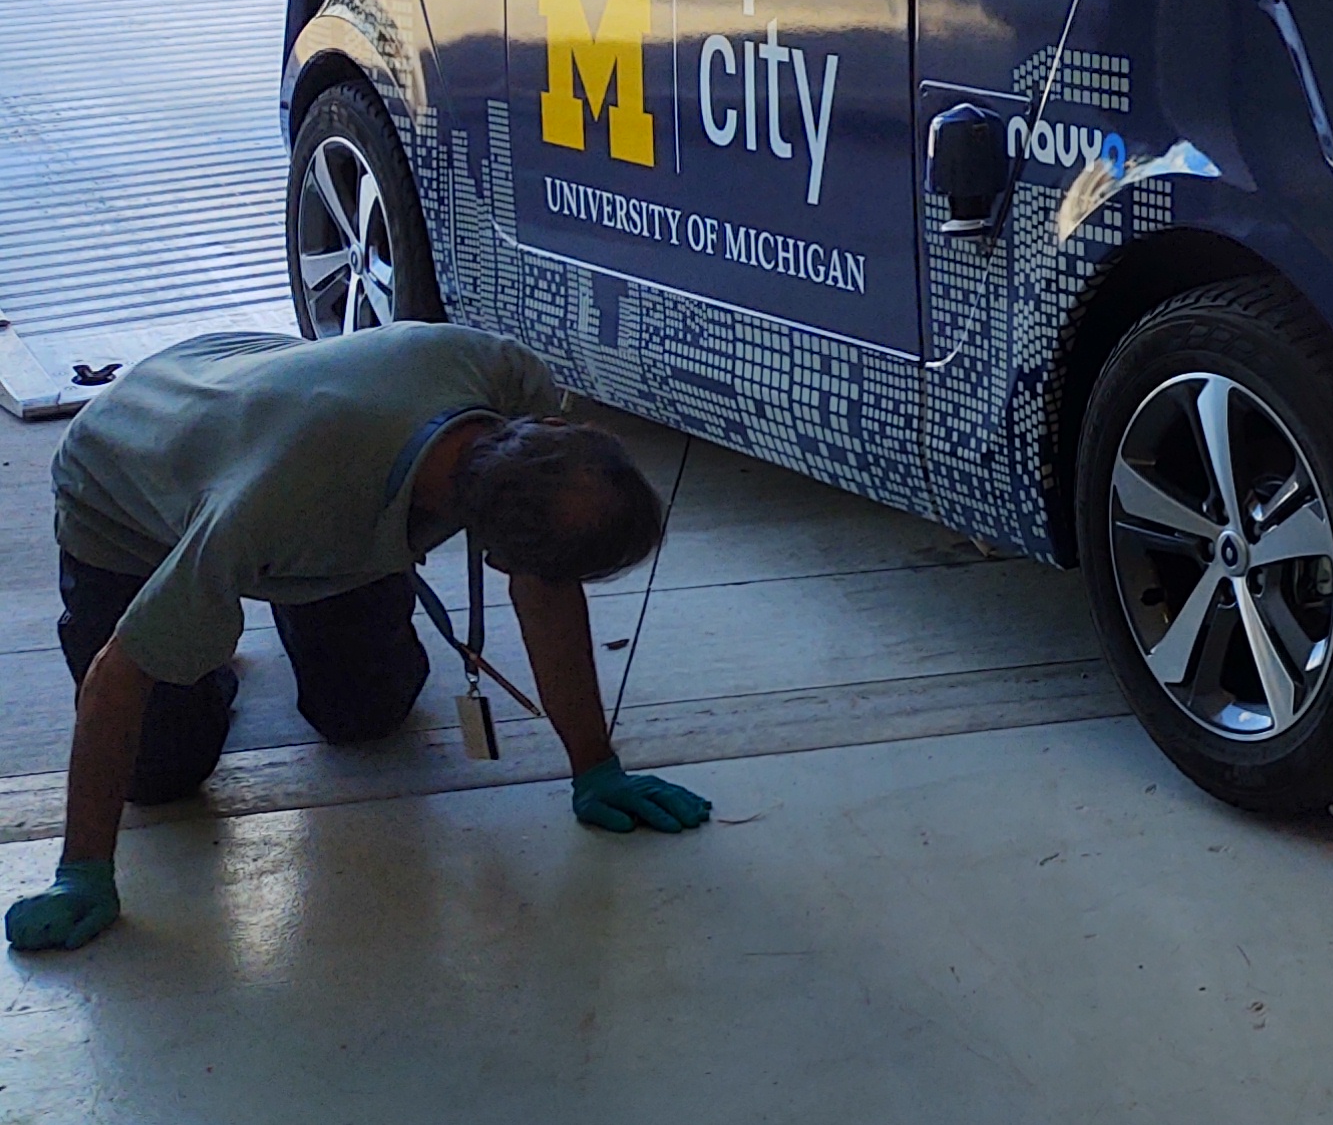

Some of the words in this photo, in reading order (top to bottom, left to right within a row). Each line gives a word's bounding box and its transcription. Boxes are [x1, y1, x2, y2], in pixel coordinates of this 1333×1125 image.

[544, 176, 681, 245] UNIVERSITY
[687, 213, 719, 255] OF
[724, 222, 866, 295] MICHIGAN
